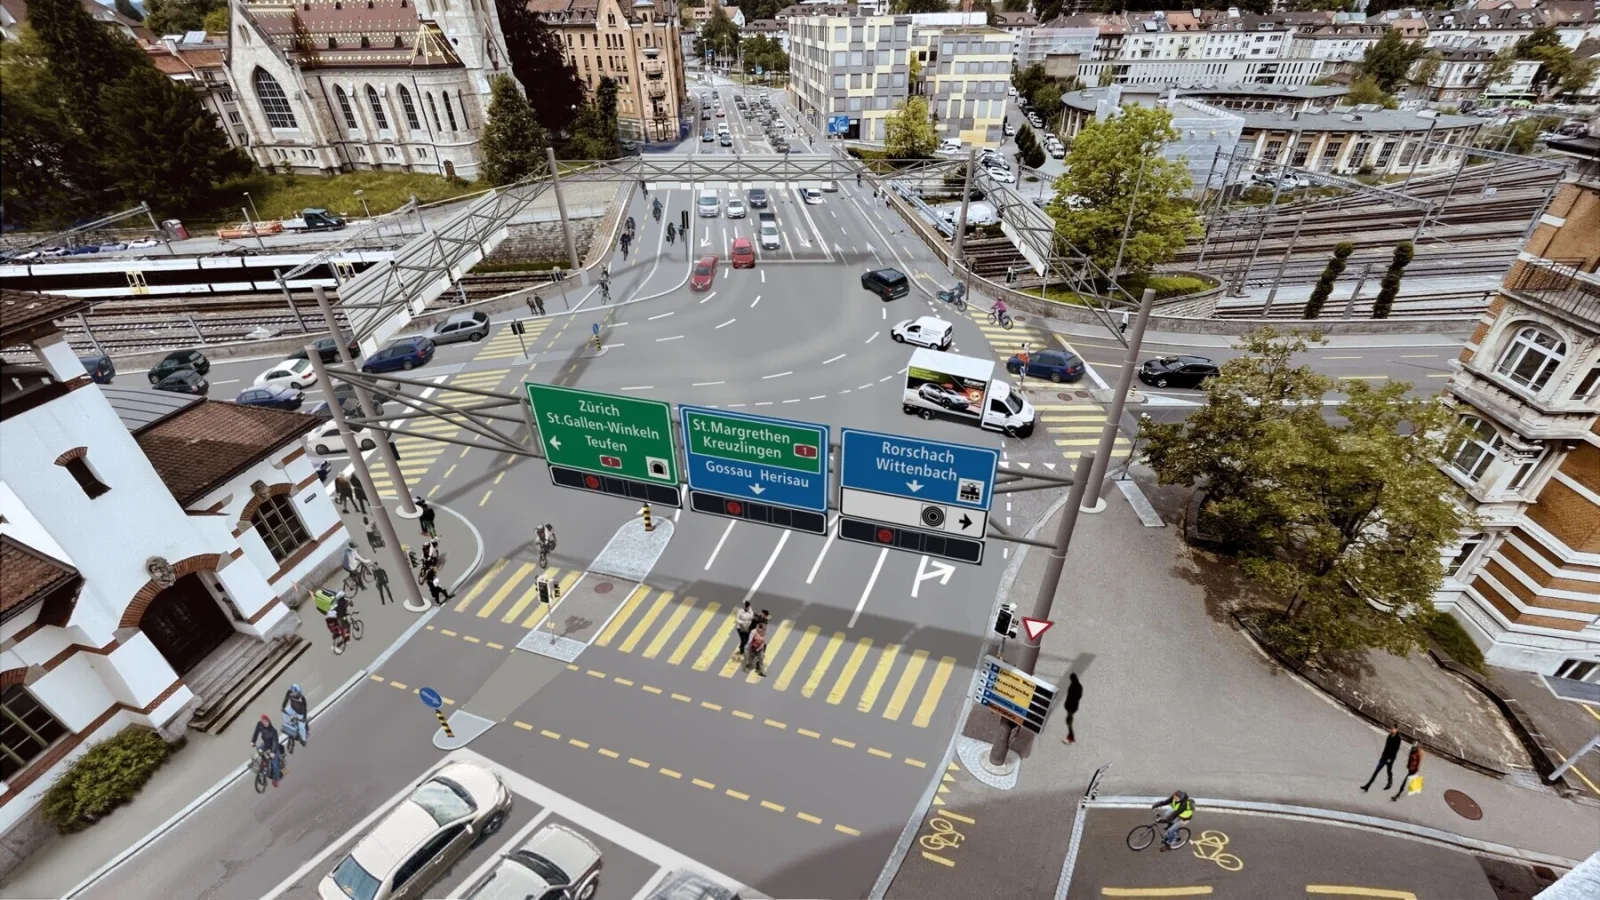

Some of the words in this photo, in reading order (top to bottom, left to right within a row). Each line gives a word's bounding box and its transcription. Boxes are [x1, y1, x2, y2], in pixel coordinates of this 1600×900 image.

[578, 400, 620, 417] Zürich
[546, 412, 660, 440] St.Gallen-Winkeln
[692, 418, 790, 444] St.Margrethen
[585, 435, 628, 453] Teufen
[703, 436, 782, 459] Kreuzlingen
[882, 441, 955, 464] Rorschach
[705, 460, 752, 478] Gossau
[760, 469, 809, 488] Herisau
[876, 457, 958, 481] Wittenbach
